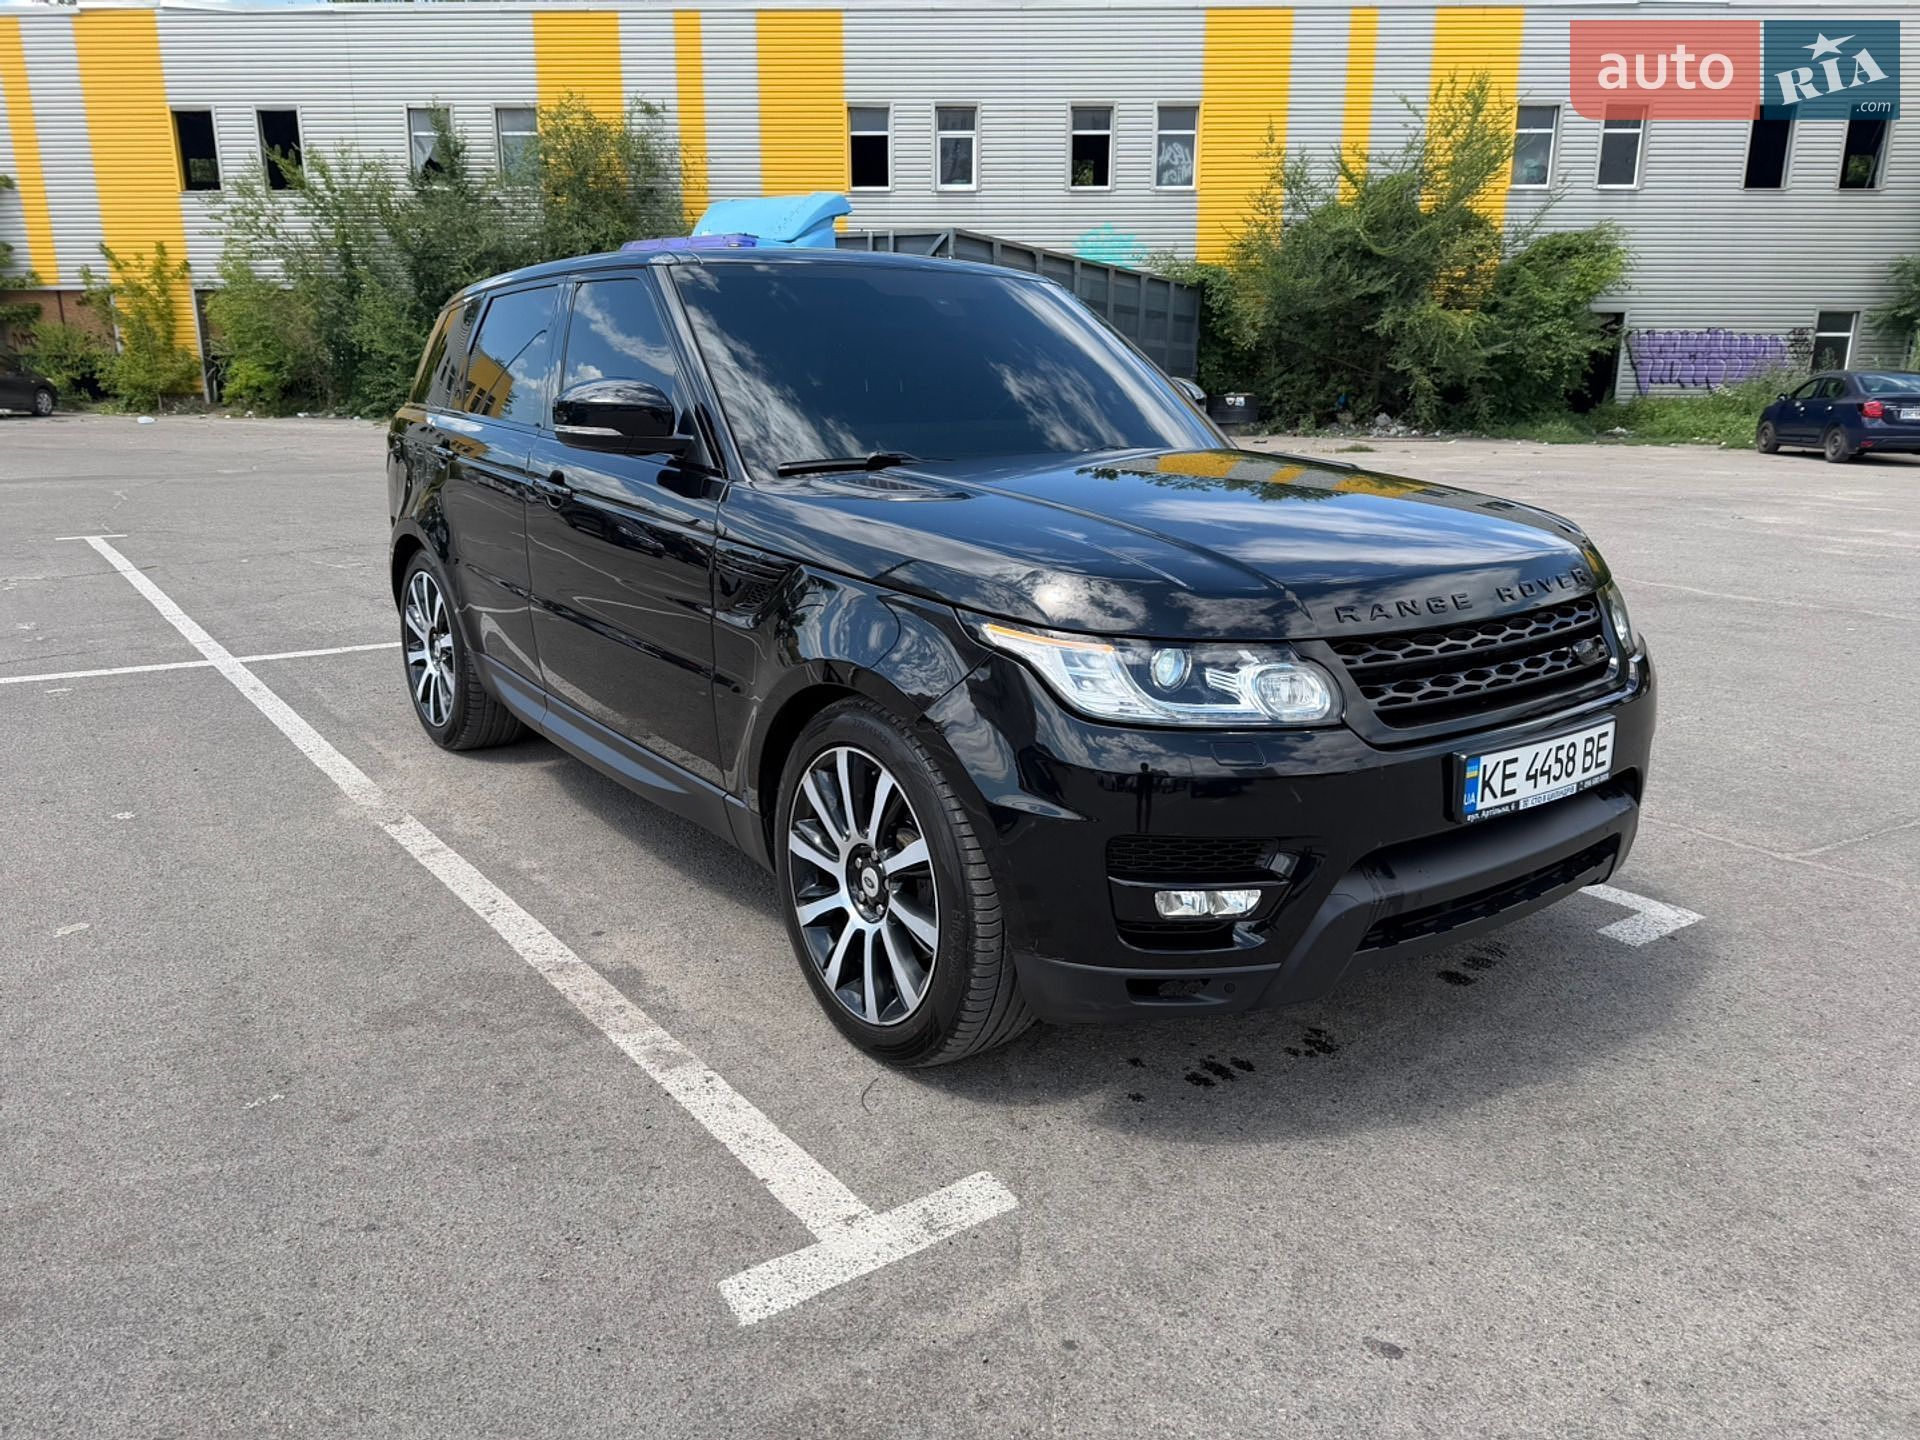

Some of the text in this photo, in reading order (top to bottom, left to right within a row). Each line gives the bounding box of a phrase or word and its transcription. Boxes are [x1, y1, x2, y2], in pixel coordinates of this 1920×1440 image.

[1334, 568, 1590, 624] RANGE ROVER
[1480, 731, 1609, 803] KE 4458 BE
[1463, 792, 1476, 806] UA
